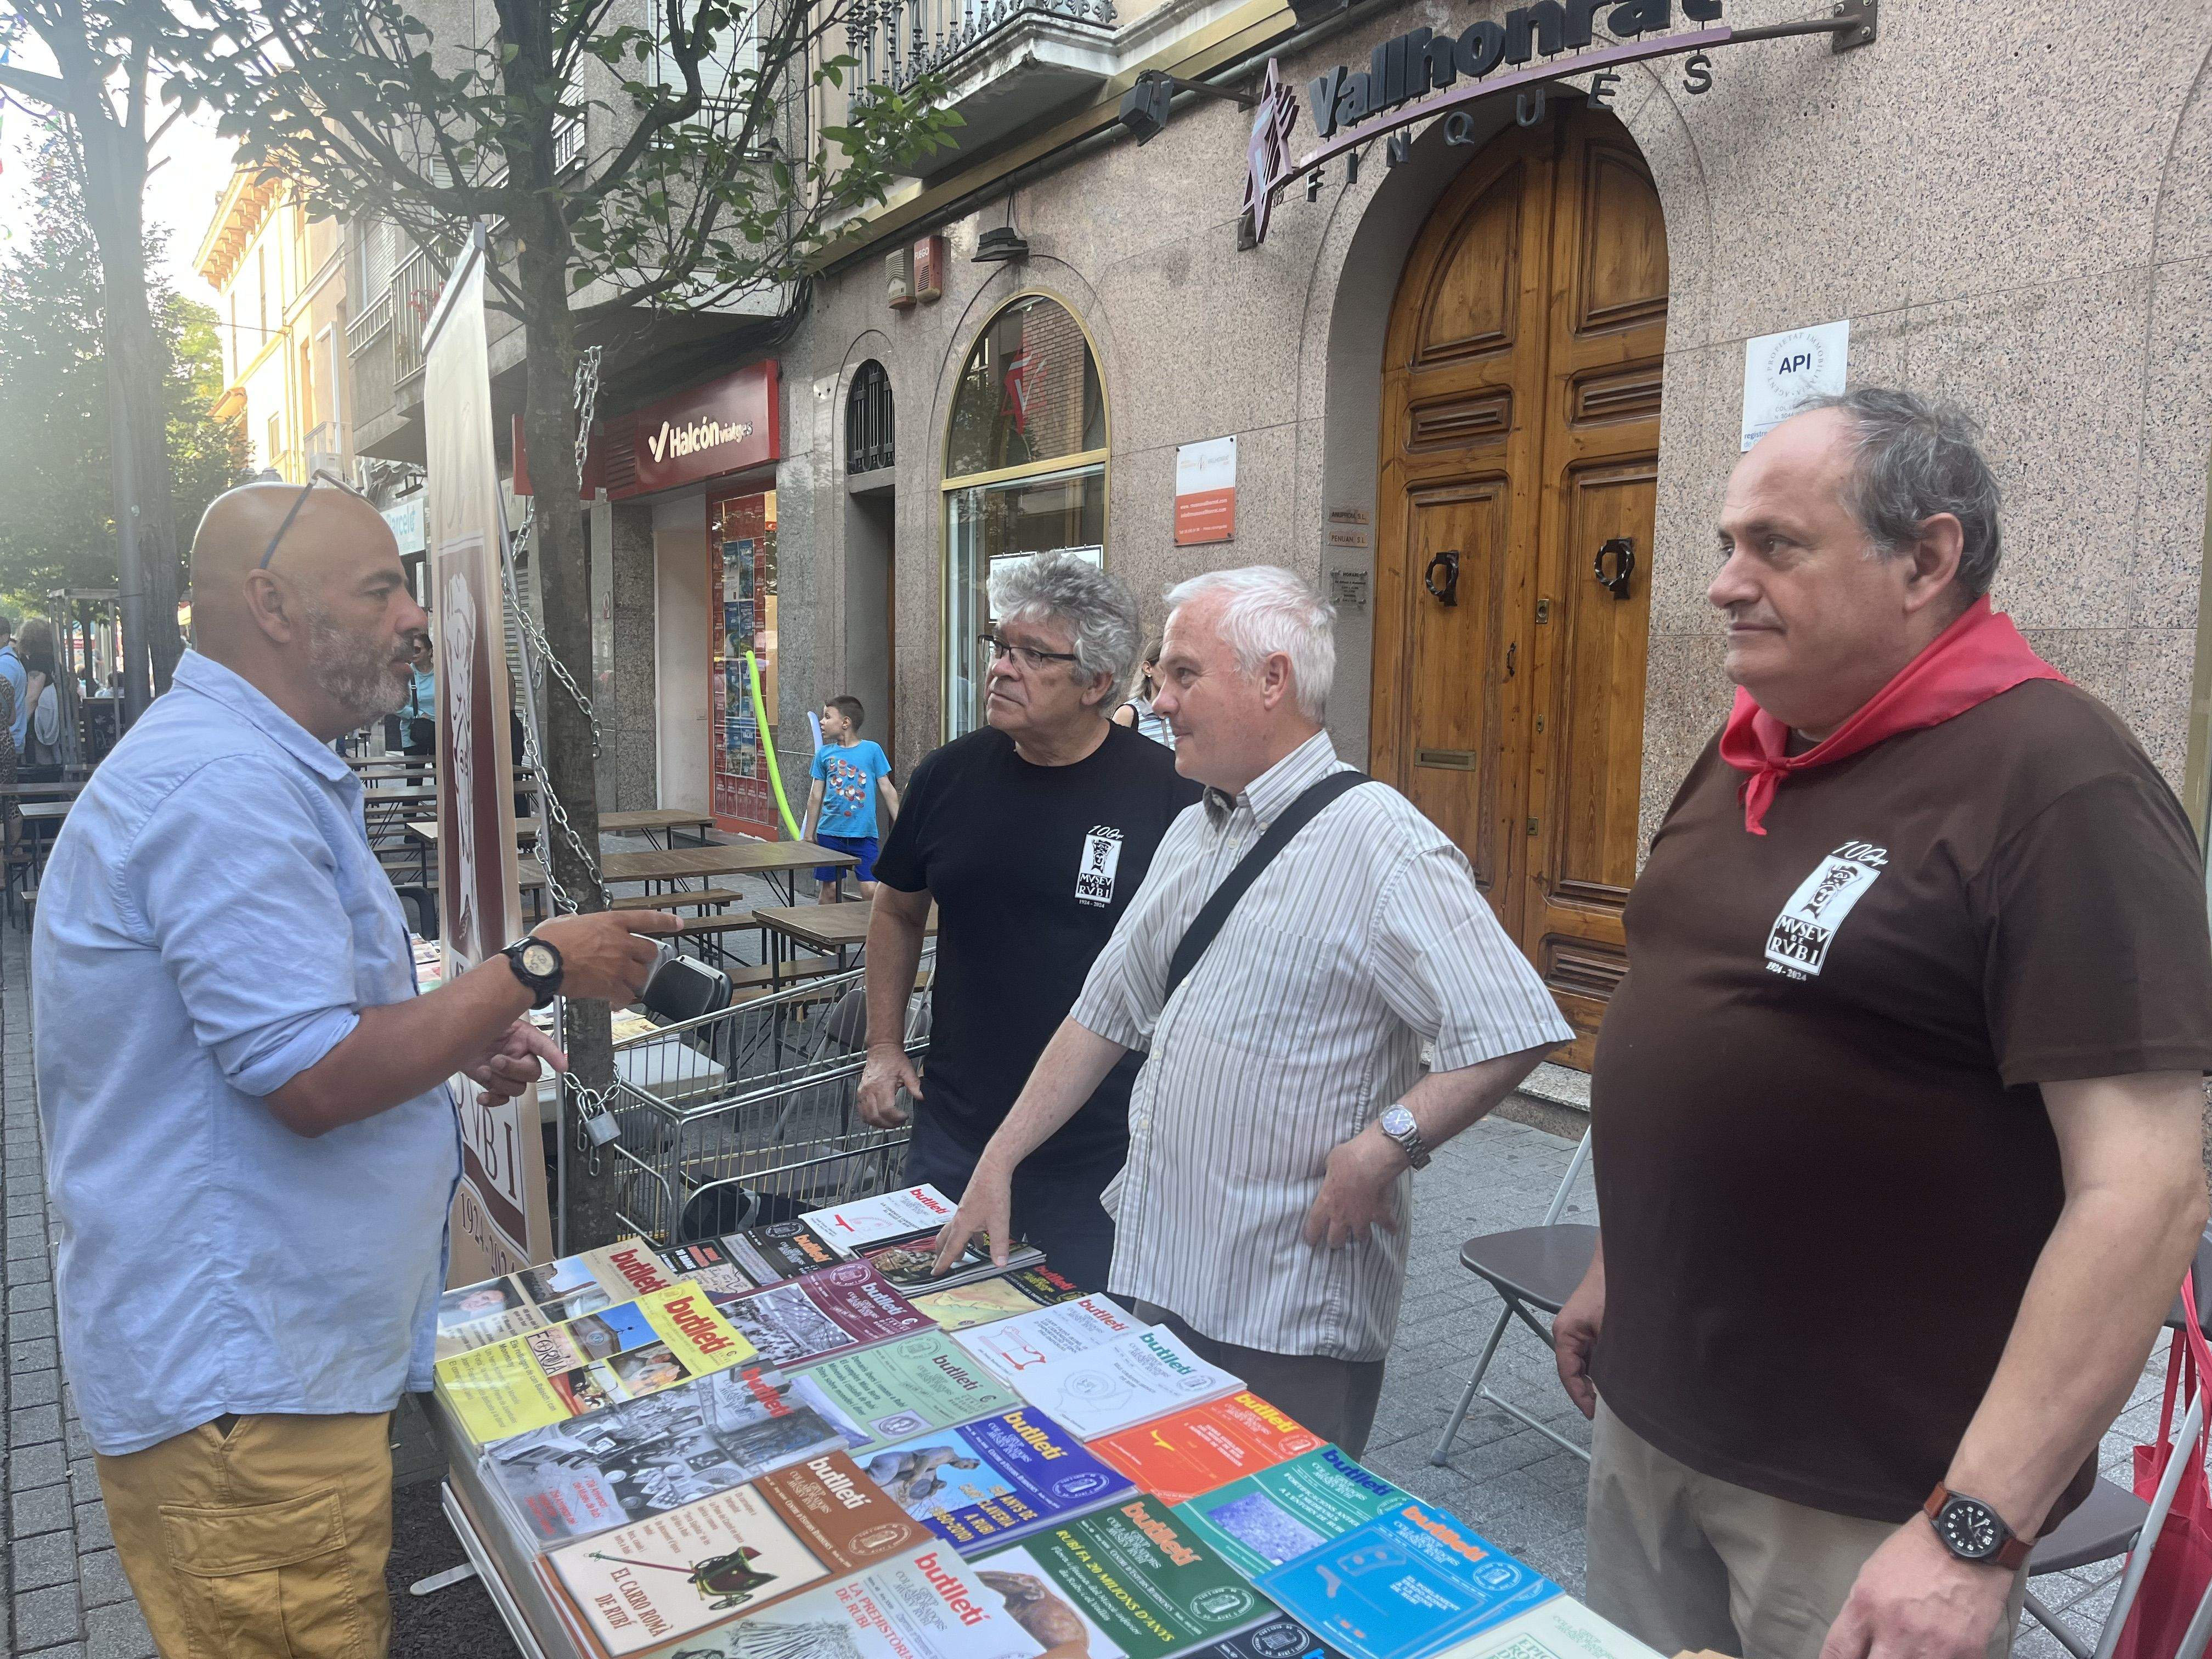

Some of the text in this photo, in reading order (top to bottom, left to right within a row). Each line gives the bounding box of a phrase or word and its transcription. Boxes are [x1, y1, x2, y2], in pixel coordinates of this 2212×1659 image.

[1308, 0, 1722, 138] Vallhonra
[1306, 54, 1713, 202] FINQUES
[915, 247, 929, 259] FUEGO
[1779, 353, 1810, 375] API
[669, 416, 753, 459] Halcón viatges
[1079, 885, 1109, 899] RVBI
[1080, 873, 1113, 887] MVSEV
[1775, 916, 1832, 943] MVSEV
[1791, 934, 1804, 944] DE
[1770, 936, 1820, 965] RVBI
[860, 1282, 907, 1316] butlletí
[662, 1295, 735, 1355] butlletí
[496, 1343, 516, 1368] Monmany
[508, 1339, 520, 1349] Els
[1139, 1331, 1197, 1376] butlletí
[1000, 1410, 1070, 1462] butlletí
[805, 1455, 872, 1510] butlletí
[1317, 1449, 1395, 1497] butlletí
[998, 1493, 1039, 1521] ANYS DE
[1054, 1528, 1087, 1552] RUBÍ
[1119, 1500, 1203, 1568] butlletí
[1074, 1549, 1094, 1562] FA
[1083, 1561, 1106, 1574] 20
[609, 1566, 675, 1637] EL CARRO ROMÀ
[911, 1551, 991, 1627] butlletí
[916, 1587, 942, 1607] GRVP
[594, 1592, 637, 1630] DE RUBÍ
[833, 1588, 876, 1629] DE RUBÍ
[845, 1582, 867, 1597] LA
[859, 1590, 913, 1659] PREHISTÒRIA
[910, 1607, 934, 1626] RVBI
[1132, 1608, 1177, 1642] D'ANYS
